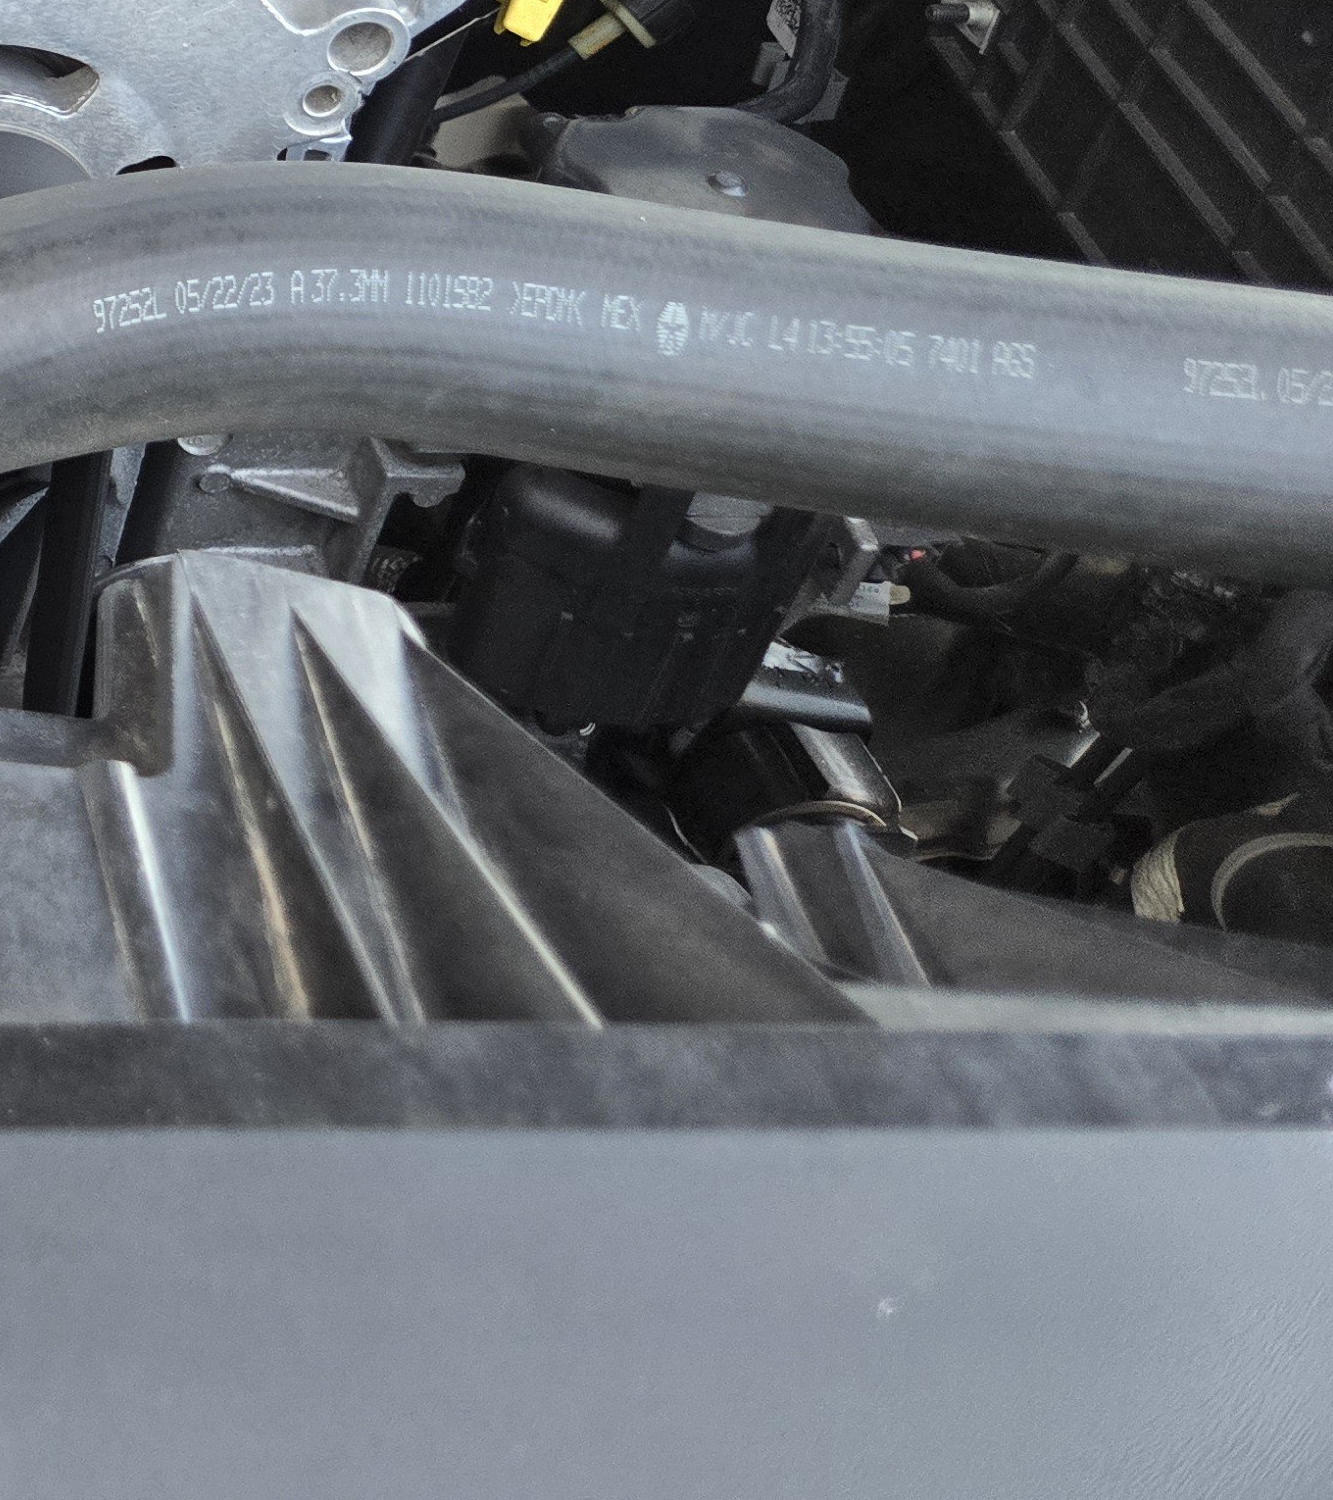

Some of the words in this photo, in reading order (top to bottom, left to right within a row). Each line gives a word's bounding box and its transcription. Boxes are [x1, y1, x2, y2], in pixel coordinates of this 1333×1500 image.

[92, 286, 167, 334] 97252L
[174, 271, 275, 314] 05/22/23
[600, 294, 641, 333] MEX
